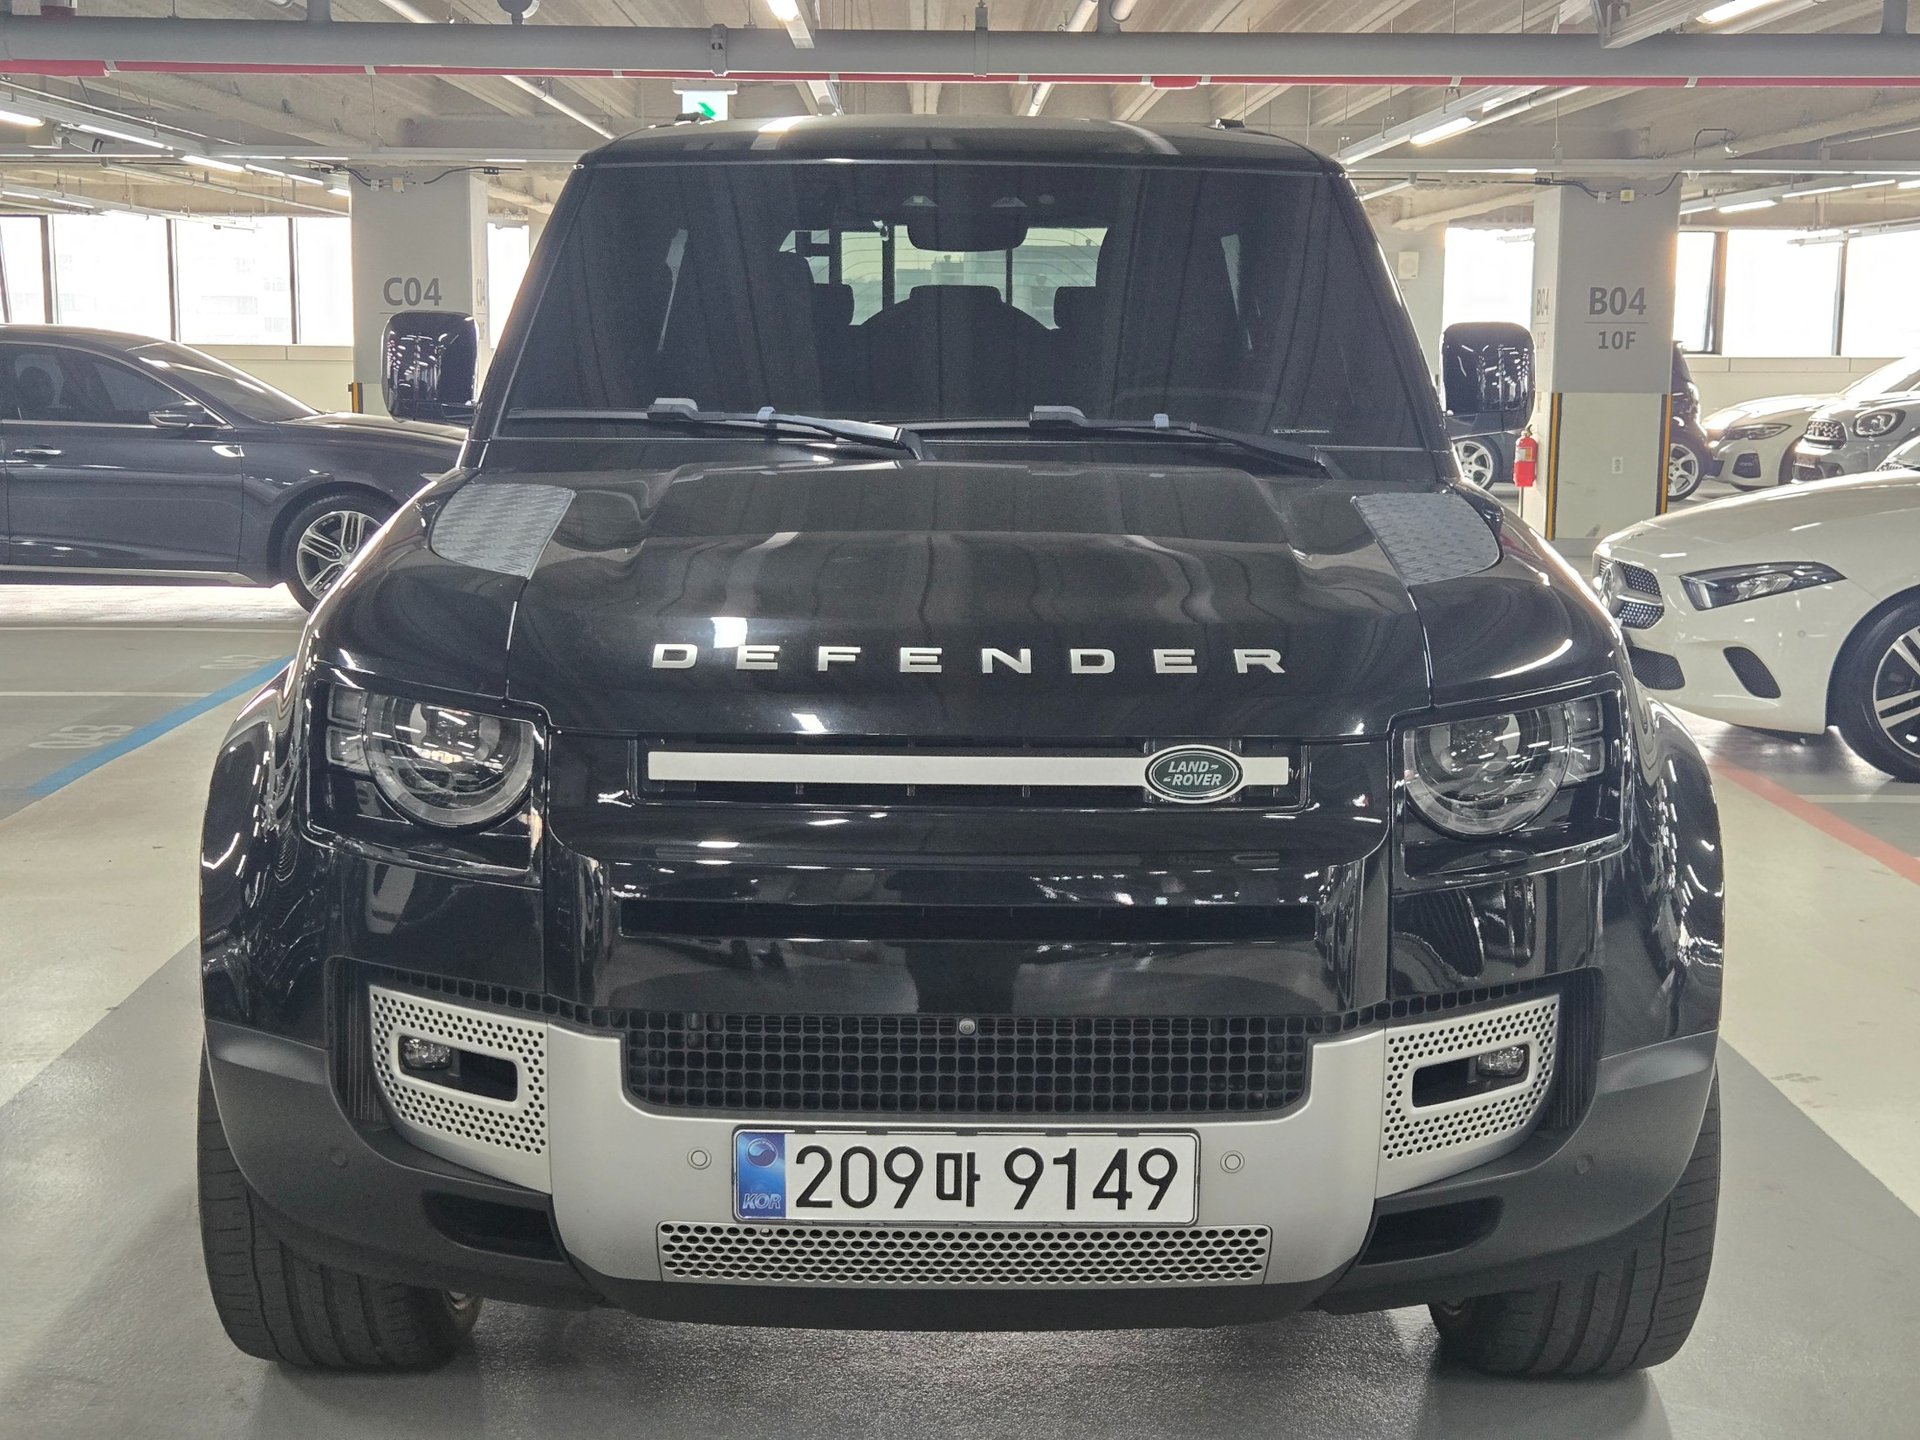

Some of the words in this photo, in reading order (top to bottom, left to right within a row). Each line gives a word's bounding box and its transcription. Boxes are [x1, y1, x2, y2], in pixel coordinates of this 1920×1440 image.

[383, 277, 442, 306] C04
[1589, 286, 1647, 316] B04
[1598, 331, 1636, 350] 10F
[651, 642, 1286, 675] DEFENDER
[28, 724, 134, 750] 043
[1168, 761, 1210, 773] LAND
[1171, 773, 1222, 786] ROVER
[795, 1144, 981, 1209] 209마
[1003, 1147, 1179, 1211] 9149
[742, 1193, 782, 1210] KOR
